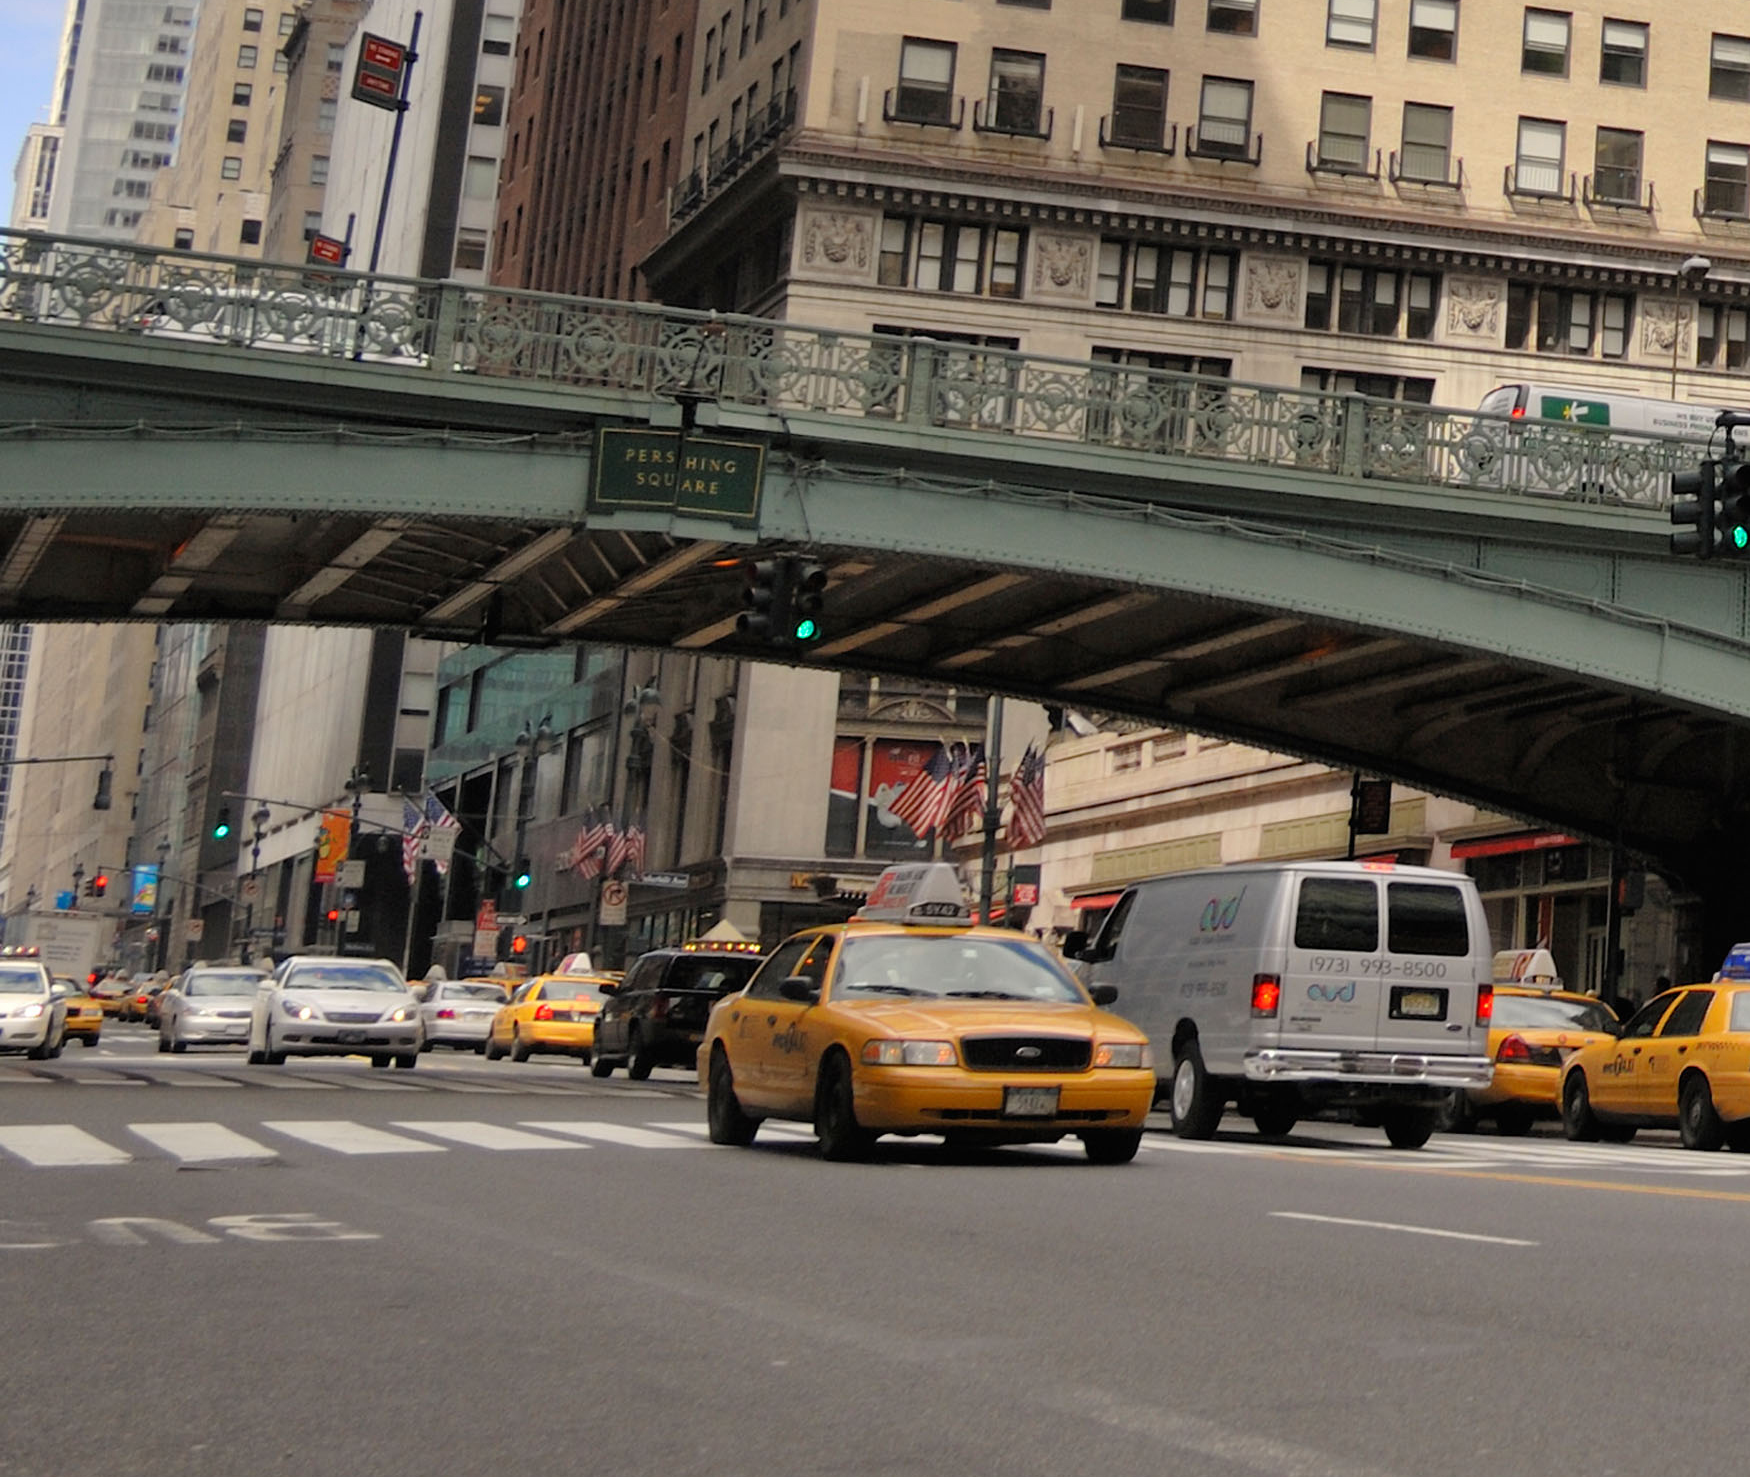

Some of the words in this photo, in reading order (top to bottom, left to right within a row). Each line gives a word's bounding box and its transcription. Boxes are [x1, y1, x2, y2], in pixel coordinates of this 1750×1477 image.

[625, 448, 737, 474] PERSHING
[636, 471, 719, 496] SQUARE
[1309, 956, 1350, 973] (973)
[1360, 958, 1447, 978] 993-8500
